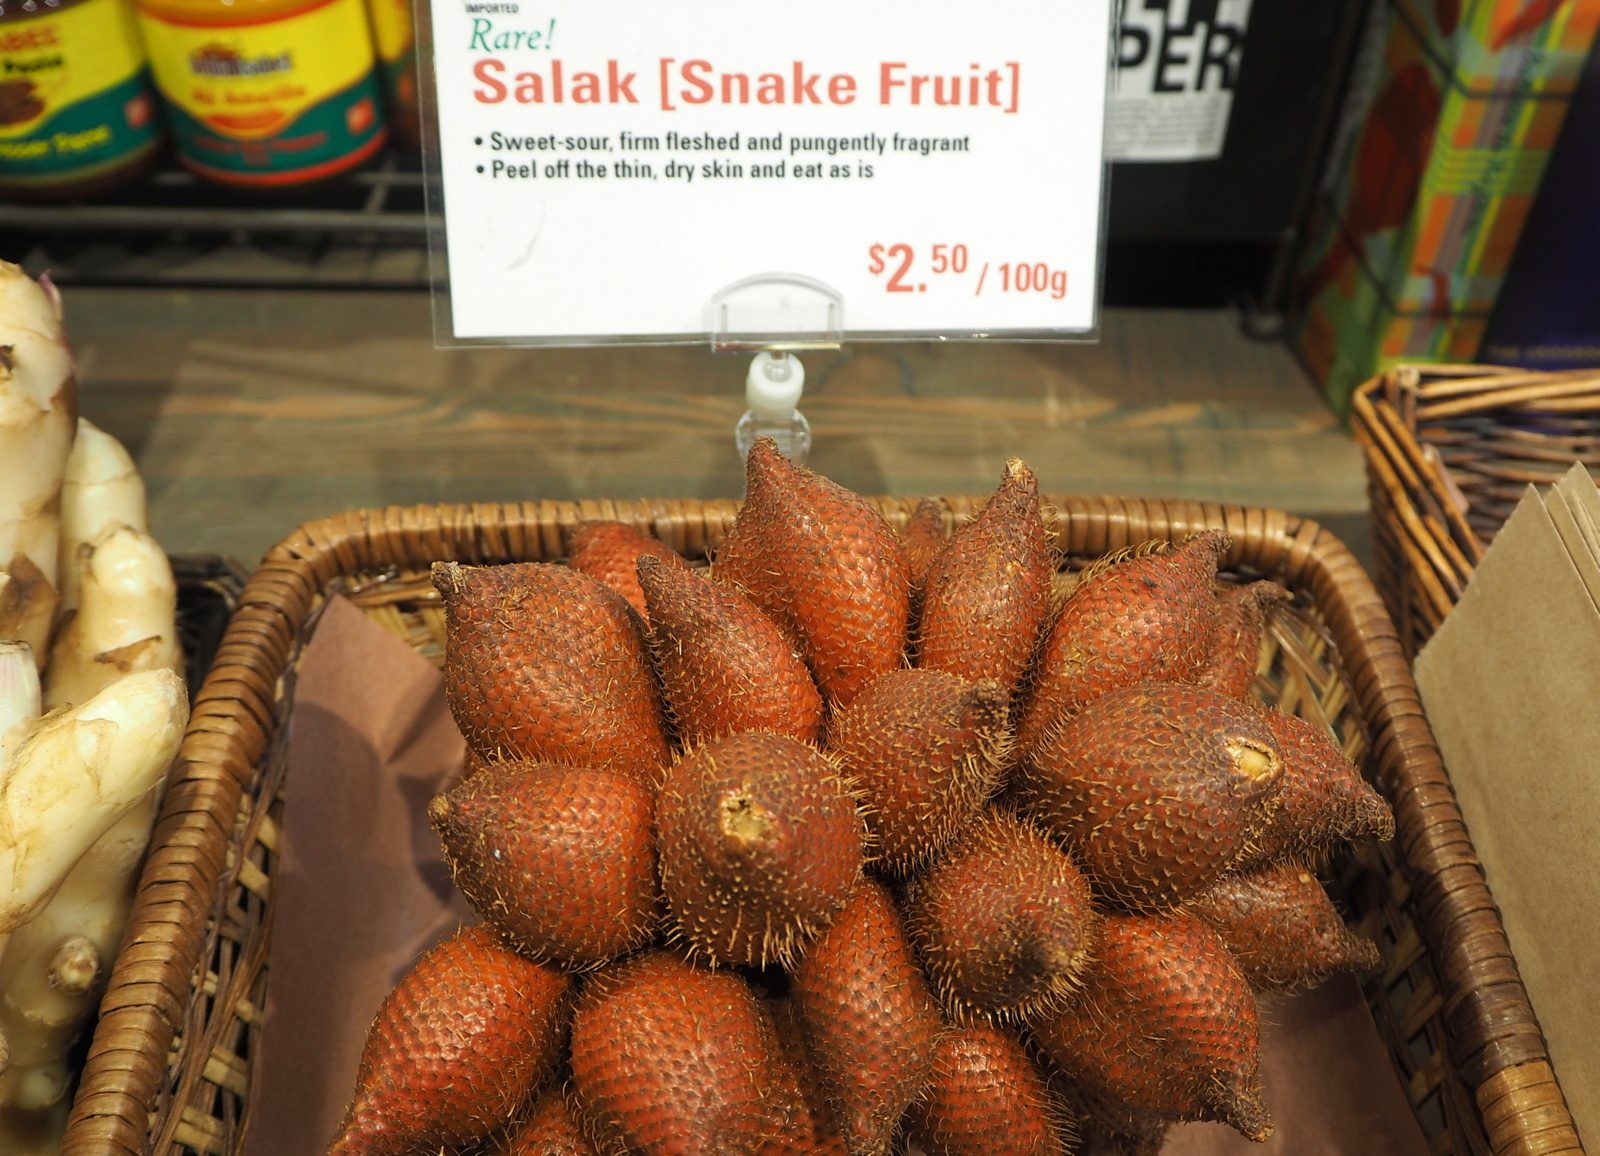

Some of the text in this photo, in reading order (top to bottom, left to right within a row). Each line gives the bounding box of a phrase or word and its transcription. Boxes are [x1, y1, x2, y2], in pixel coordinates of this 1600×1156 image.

[465, 3, 519, 14] IMPORTED
[468, 17, 556, 52] Rare!
[472, 57, 1021, 114] Salak [Snake Fruit]
[490, 131, 970, 156] Sweet-sour, firm fleshed and pungently fragrant
[492, 159, 874, 183] Peel off the thin, dry skin and eat as is
[998, 262, 1068, 300] 100g
